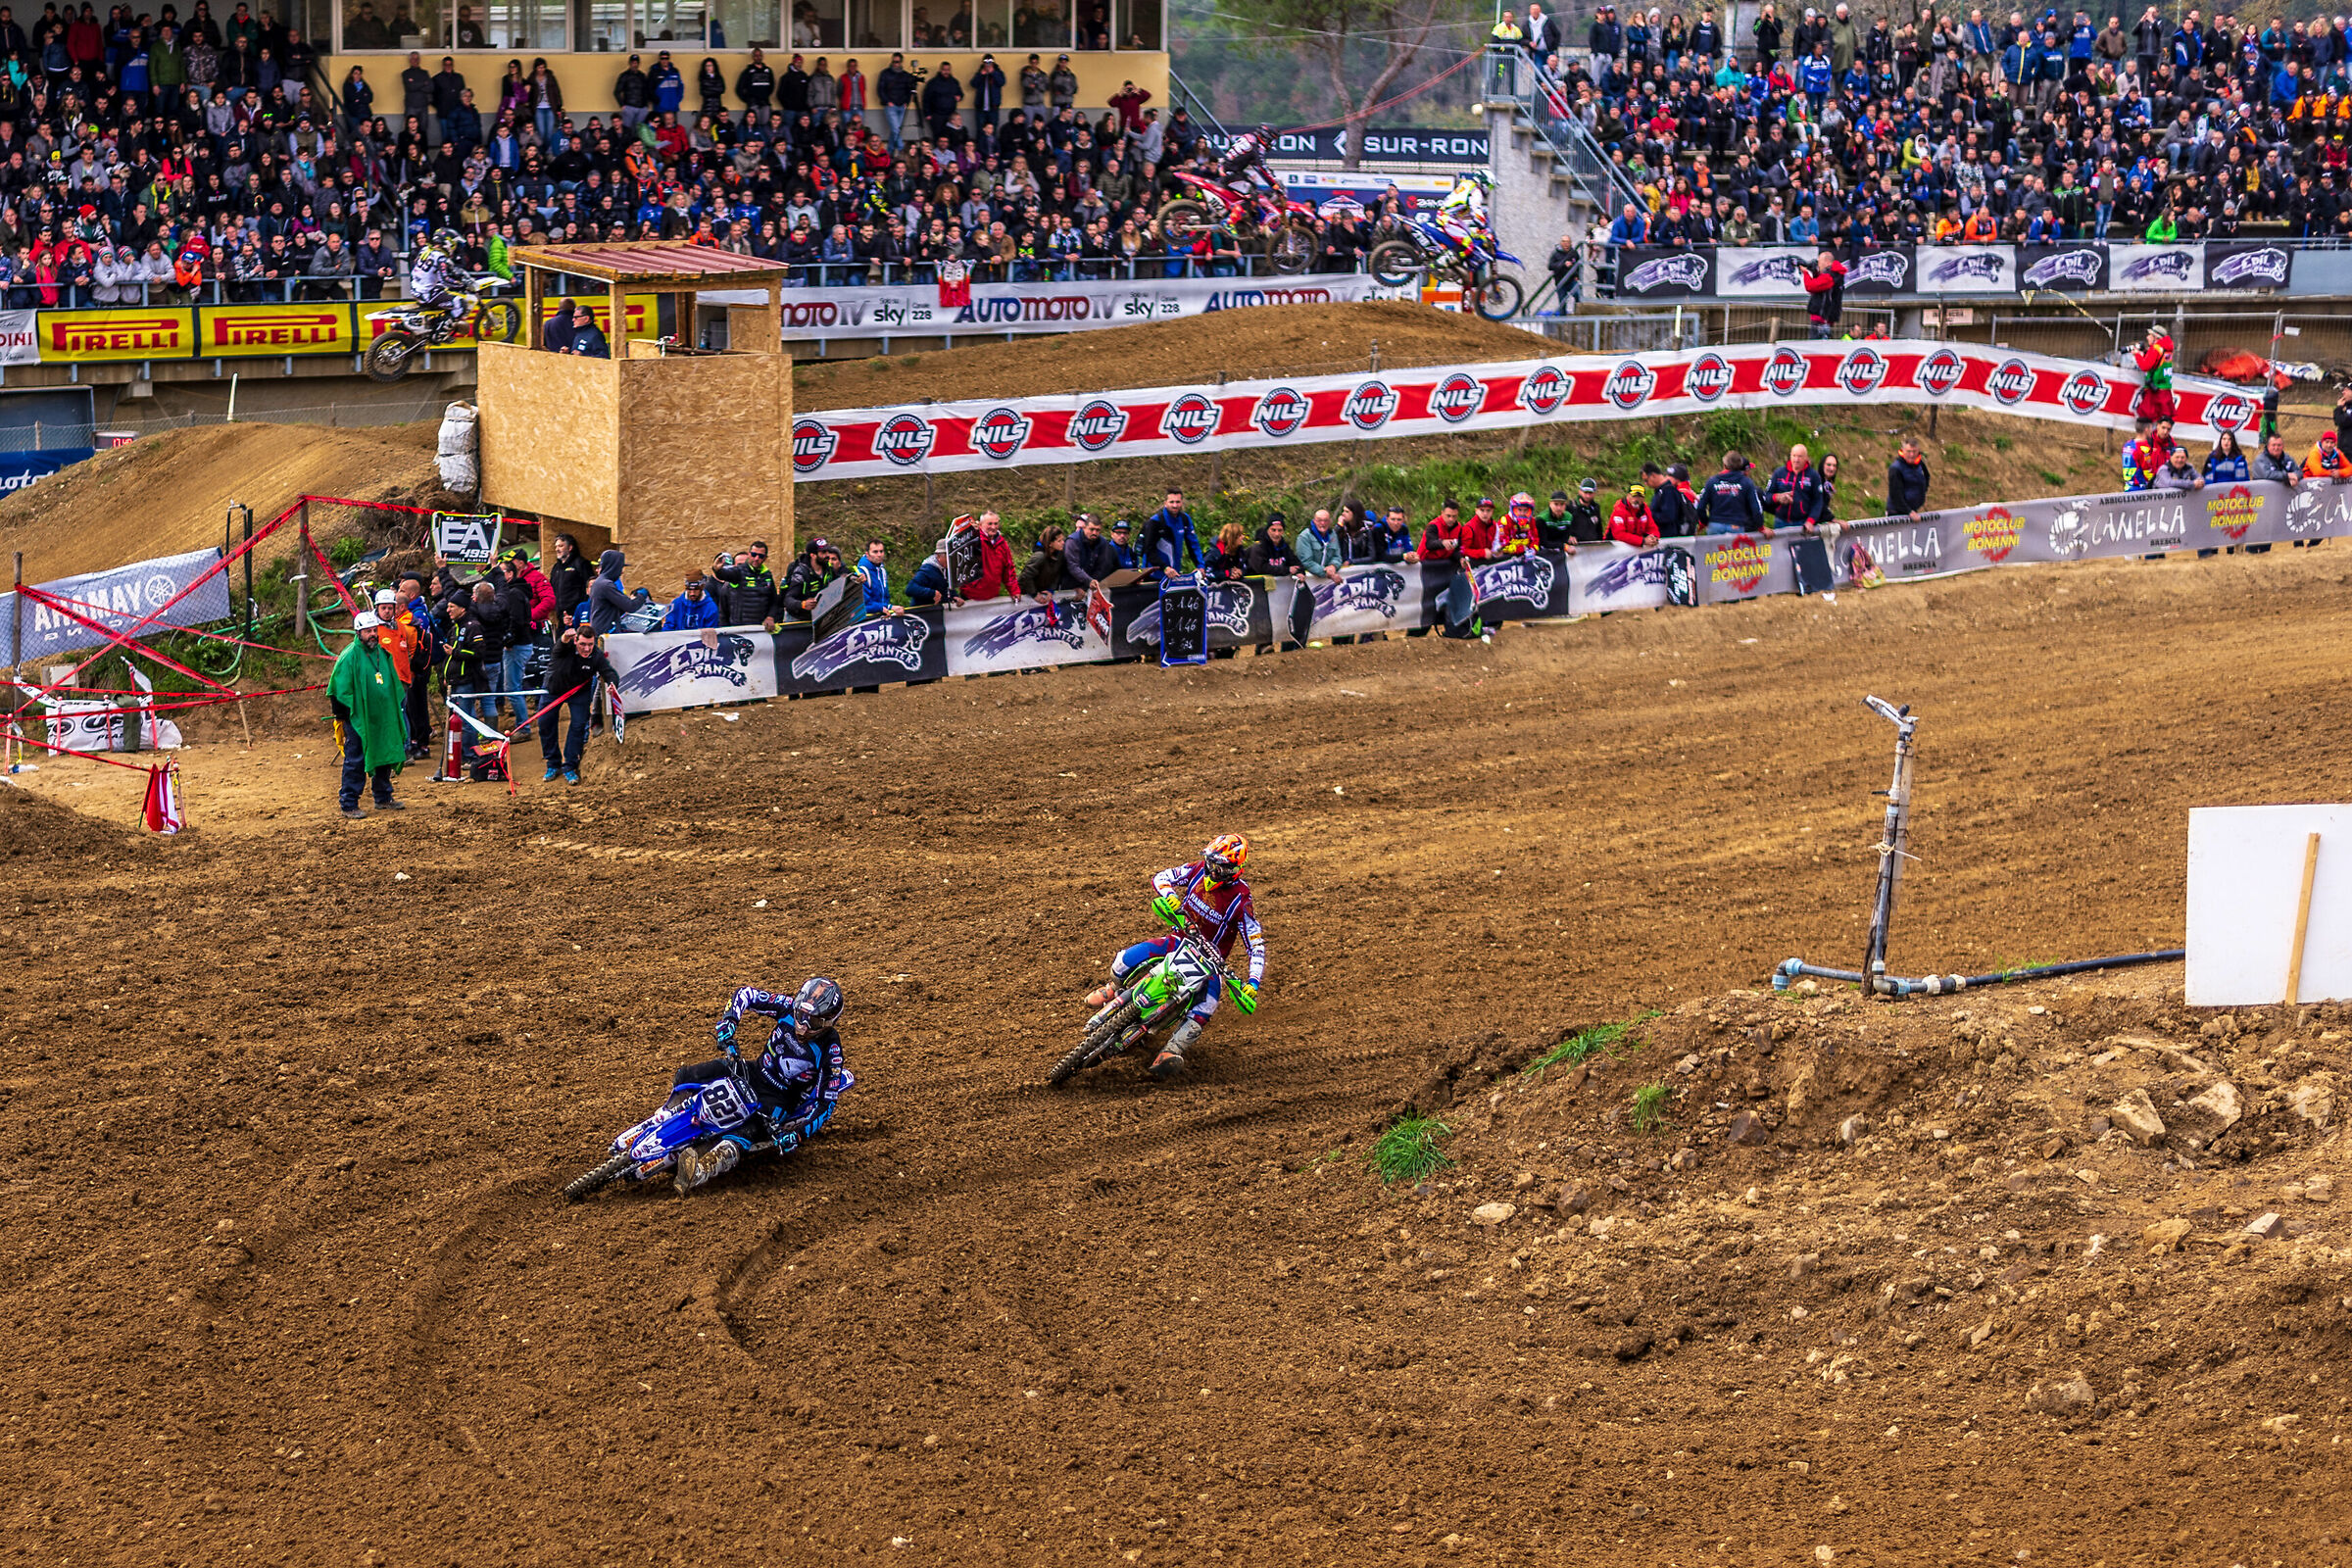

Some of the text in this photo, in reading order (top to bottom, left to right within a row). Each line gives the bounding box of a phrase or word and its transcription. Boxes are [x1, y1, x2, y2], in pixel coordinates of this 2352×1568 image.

[1364, 136, 1489, 155] SUR-RON
[873, 304, 906, 325] sky
[911, 311, 932, 320] 228
[1124, 298, 1154, 318] sky
[1160, 303, 1180, 313] 228
[52, 318, 179, 351] PIRELLI
[214, 314, 338, 346] PIRELLI
[1688, 367, 1733, 388] NILS
[1765, 362, 1807, 384] NILS
[1840, 362, 1886, 382] NILS
[1919, 364, 1966, 383] NILS
[1989, 372, 2035, 392] NILS
[1521, 376, 1575, 400] NILS
[1608, 374, 1654, 395] NILS
[2063, 382, 2108, 404] NILS
[1346, 393, 1396, 416] NILS
[1432, 386, 1485, 410] NILS
[1164, 408, 1220, 429] NILS
[1254, 396, 1310, 422] NILS
[2207, 404, 2254, 422] NILS
[974, 420, 1028, 444] NILS
[1072, 414, 1126, 437] NILS
[793, 434, 836, 456] ILS
[878, 427, 934, 450] NILS
[2099, 491, 2187, 505] ABBIGLIAMENTO MOTO
[2206, 495, 2266, 513] MOTOCLUB
[1963, 516, 2027, 534] MOTOCLUB
[2091, 505, 2187, 545] CANELLA
[2210, 513, 2259, 528] BONANNI
[440, 521, 490, 552] EA
[1967, 533, 2020, 552] BONANNI
[2150, 538, 2181, 547] BRESCIA
[460, 549, 491, 559] 499
[1704, 544, 1772, 565] MOTOCLUB
[1840, 527, 1941, 568] CNELLA
[1711, 563, 1770, 583] BONANNI
[1207, 612, 1243, 628] ANTER
[1035, 627, 1080, 647] PANTER
[867, 644, 911, 665] PANTER
[695, 662, 743, 684] PANTER
[1189, 893, 1223, 922] FIAMME ORO
[702, 1084, 745, 1127] 821
